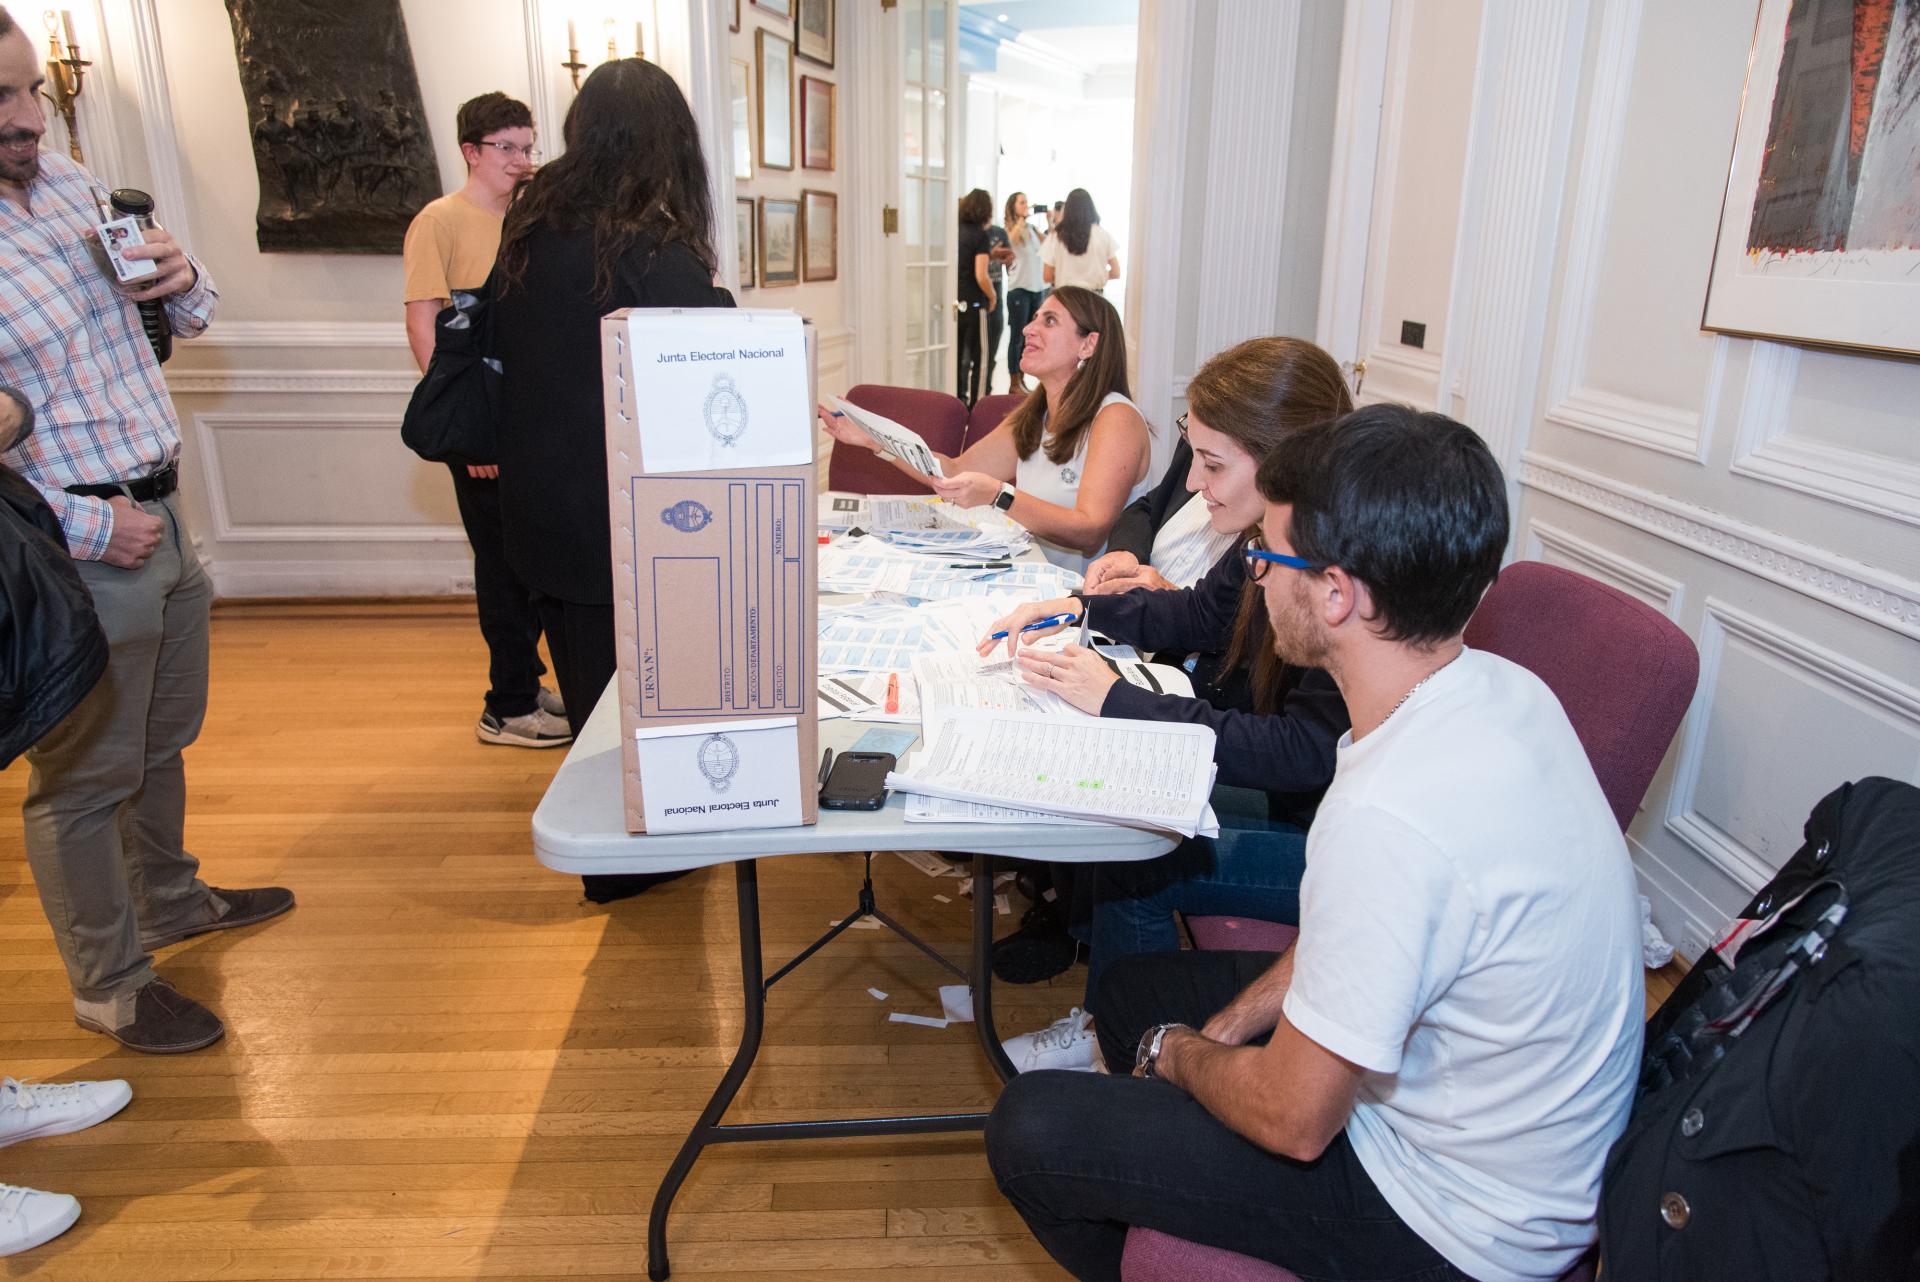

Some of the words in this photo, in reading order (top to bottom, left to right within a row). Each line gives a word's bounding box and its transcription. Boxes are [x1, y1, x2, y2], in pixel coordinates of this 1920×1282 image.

[657, 352, 687, 363] Junta
[690, 350, 735, 361] Electoral
[739, 348, 784, 359] Nacional
[645, 666, 654, 699] URNA
[709, 801, 750, 813] Electoral
[753, 798, 779, 808] Junta
[664, 805, 706, 816] Nacional
